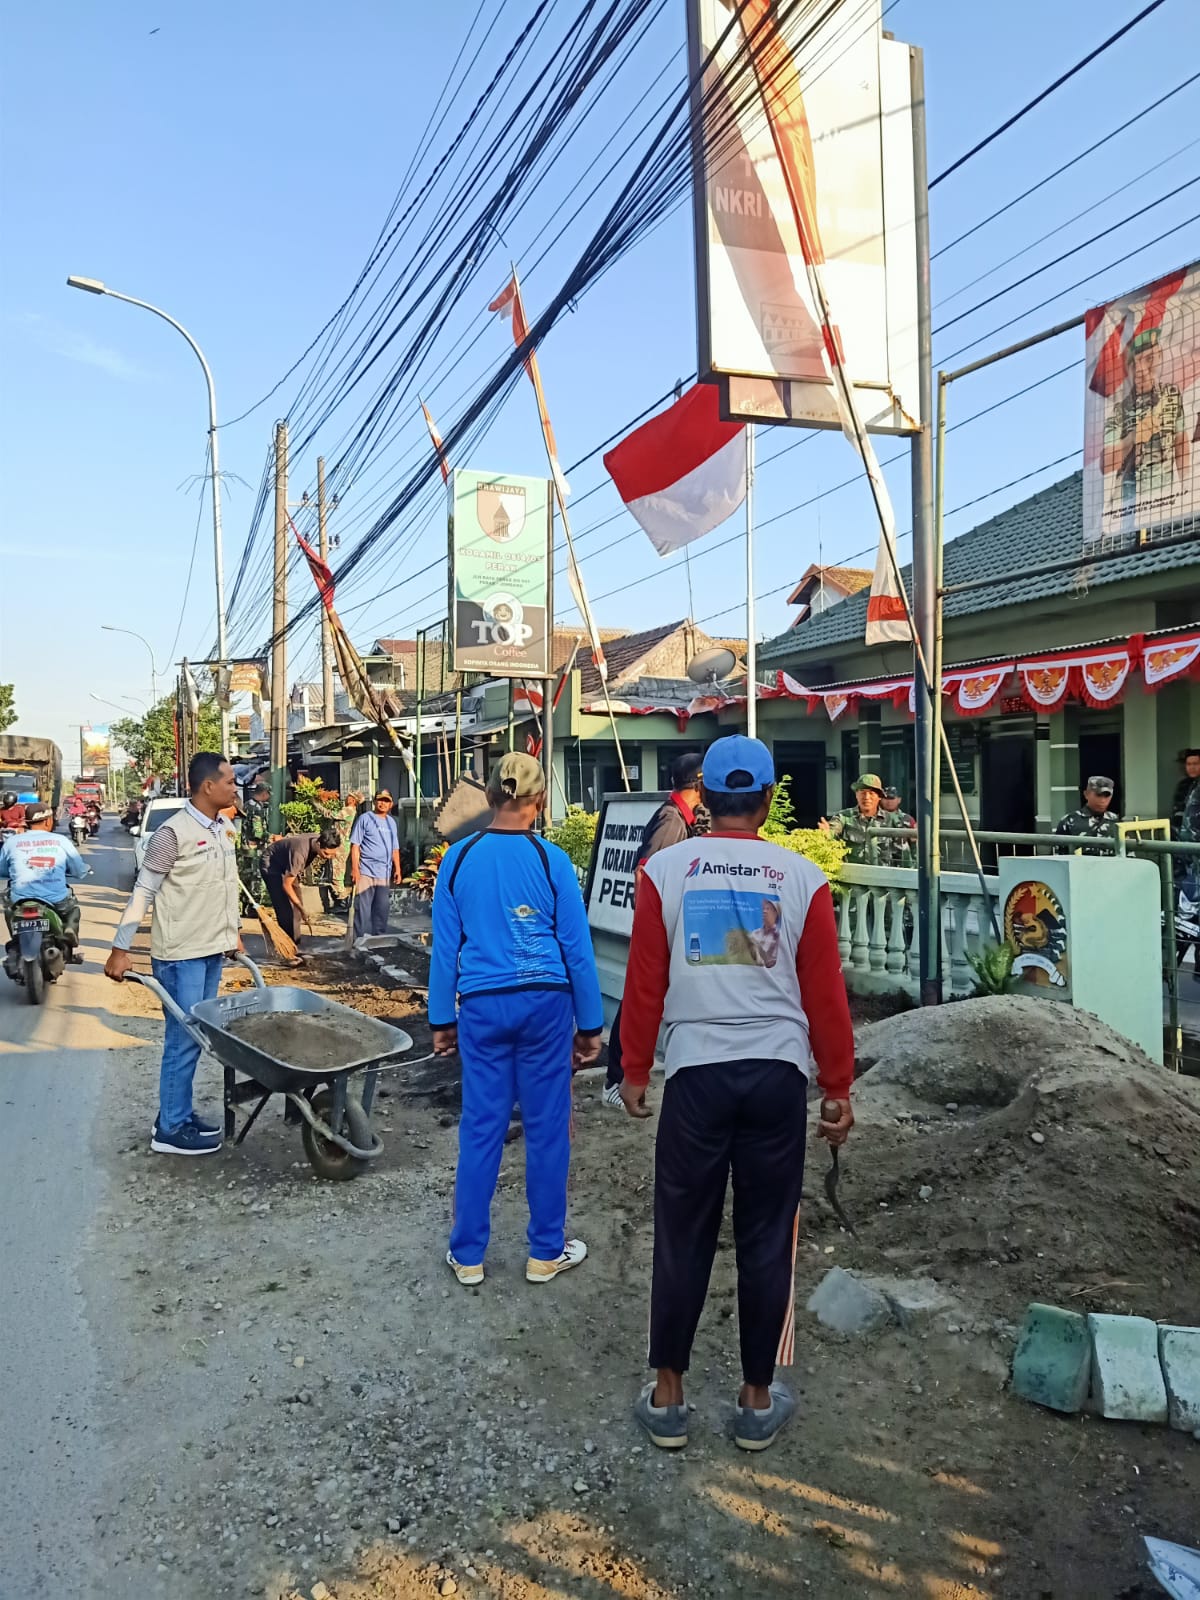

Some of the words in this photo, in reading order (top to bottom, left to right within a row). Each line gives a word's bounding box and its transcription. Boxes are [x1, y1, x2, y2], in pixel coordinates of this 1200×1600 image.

[715, 186, 762, 218] NKRI
[471, 620, 533, 647] TOP
[494, 646, 527, 658] Coffee
